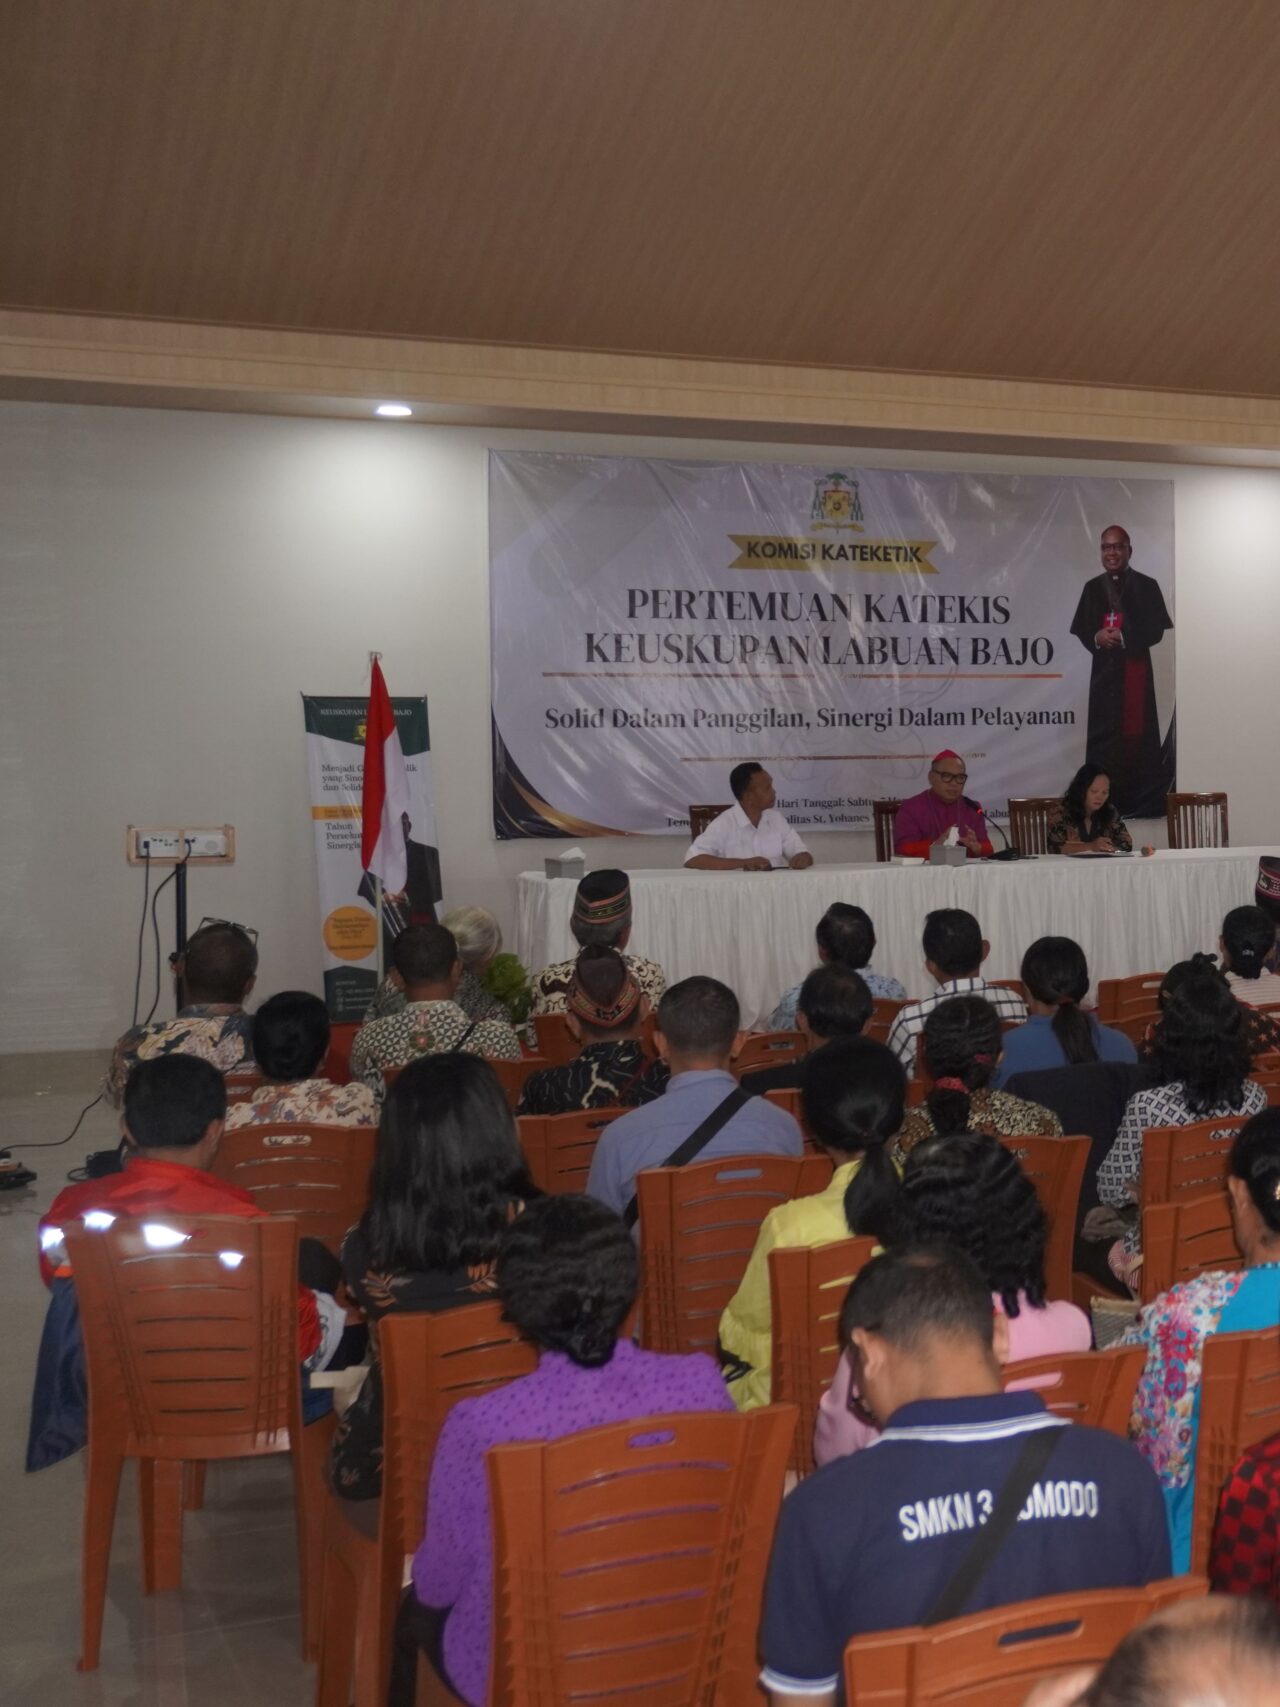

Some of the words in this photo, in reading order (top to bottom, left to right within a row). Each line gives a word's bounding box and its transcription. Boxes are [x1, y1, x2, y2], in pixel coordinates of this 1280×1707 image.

[747, 541, 816, 560] KOMISI
[821, 543, 923, 563] KATEKETIK
[626, 588, 852, 622] PERTEMUAN
[863, 593, 1011, 625] KATEKIS
[584, 632, 810, 665] KEUSKUPAN
[821, 635, 960, 666] LABUAN
[970, 636, 1054, 666] BAJO
[545, 708, 604, 729] Solid
[612, 708, 686, 729] Dalam
[693, 708, 811, 733] Panggilan,
[817, 708, 893, 732] Sinergi
[899, 707, 966, 728] Dalam
[972, 707, 1076, 731] Pelayanan
[777, 799, 799, 808] Hari
[801, 797, 845, 810] Tanggal:
[325, 822, 353, 830] Tahun
[813, 813, 826, 823] St.
[828, 813, 871, 823] Yohanes
[899, 1490, 975, 1542] SMKN
[1016, 1479, 1100, 1522] OMODO
